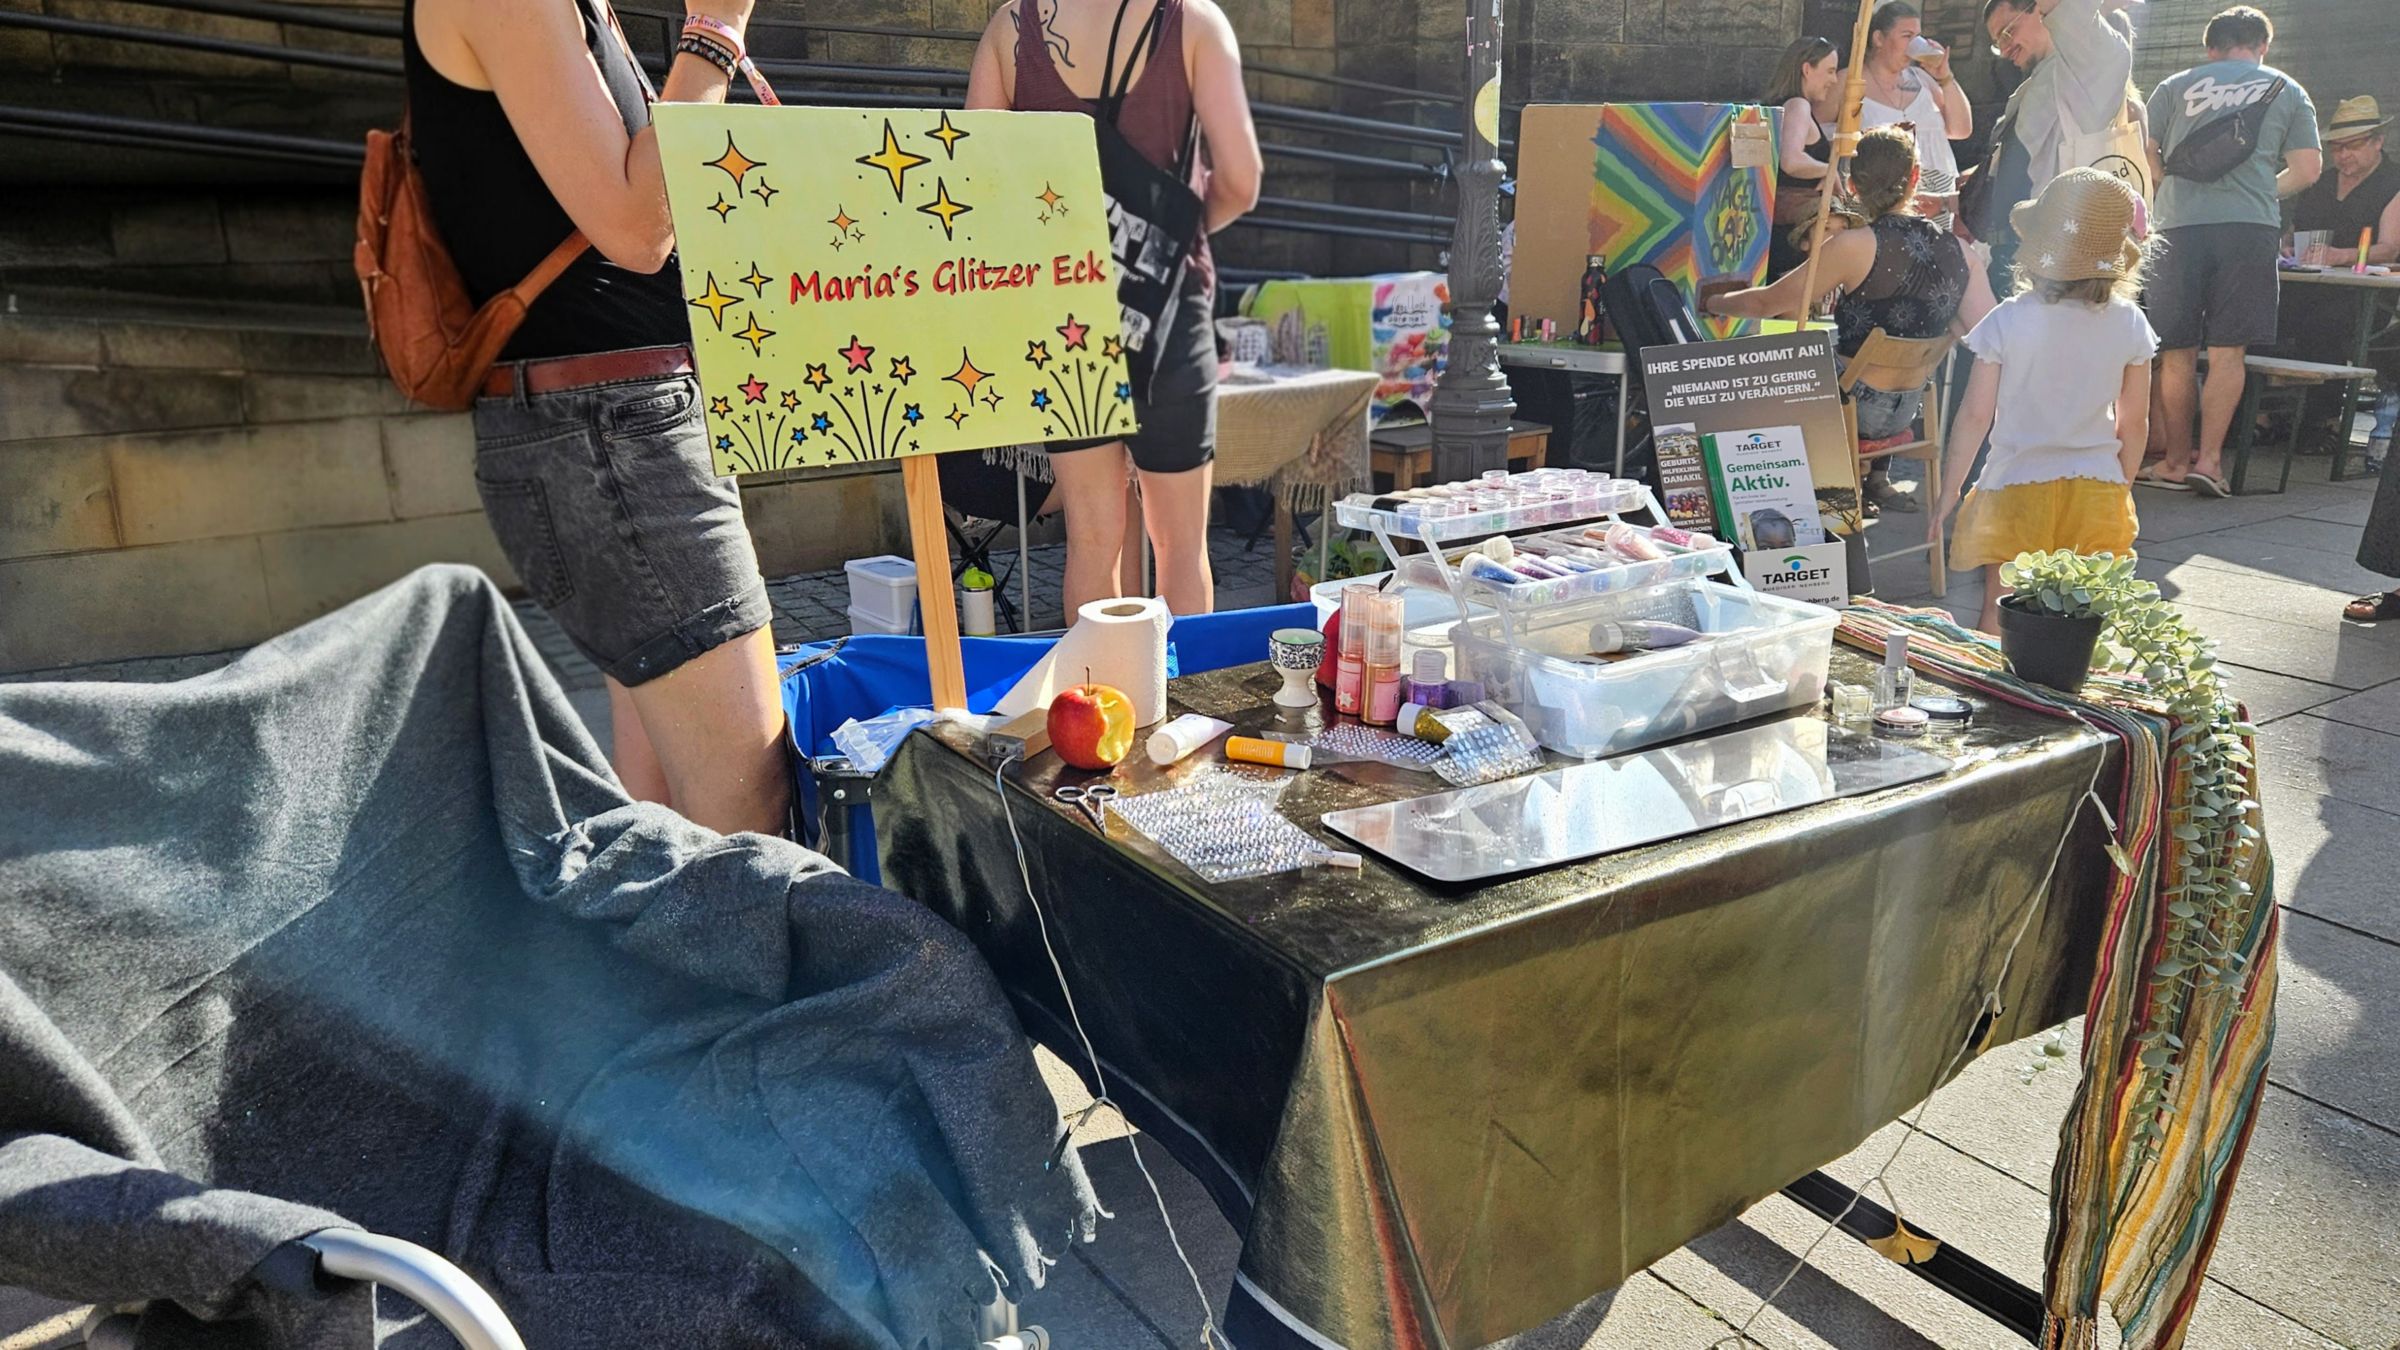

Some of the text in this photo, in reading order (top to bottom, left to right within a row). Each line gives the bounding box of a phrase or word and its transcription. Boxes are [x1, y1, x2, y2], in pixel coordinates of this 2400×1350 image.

[789, 250, 1107, 305] Maria‘s Glitzer Eck
[1647, 343, 1825, 375] IHRE SPENDE KOMMT AN!
[1666, 369, 1817, 397] „NIEMAND IST ZU GERING
[1664, 396, 1685, 409] DIE
[1686, 393, 1718, 407] WELT
[1719, 391, 1736, 403] ZU
[1736, 440, 1782, 452] TARGET
[1660, 457, 1699, 468] GEBURTS-
[1726, 457, 1805, 474] Gemeinsam.
[1663, 473, 1704, 485] DANAKIL
[1731, 473, 1790, 492] Aktiv.
[1762, 568, 1830, 585] TARGET
